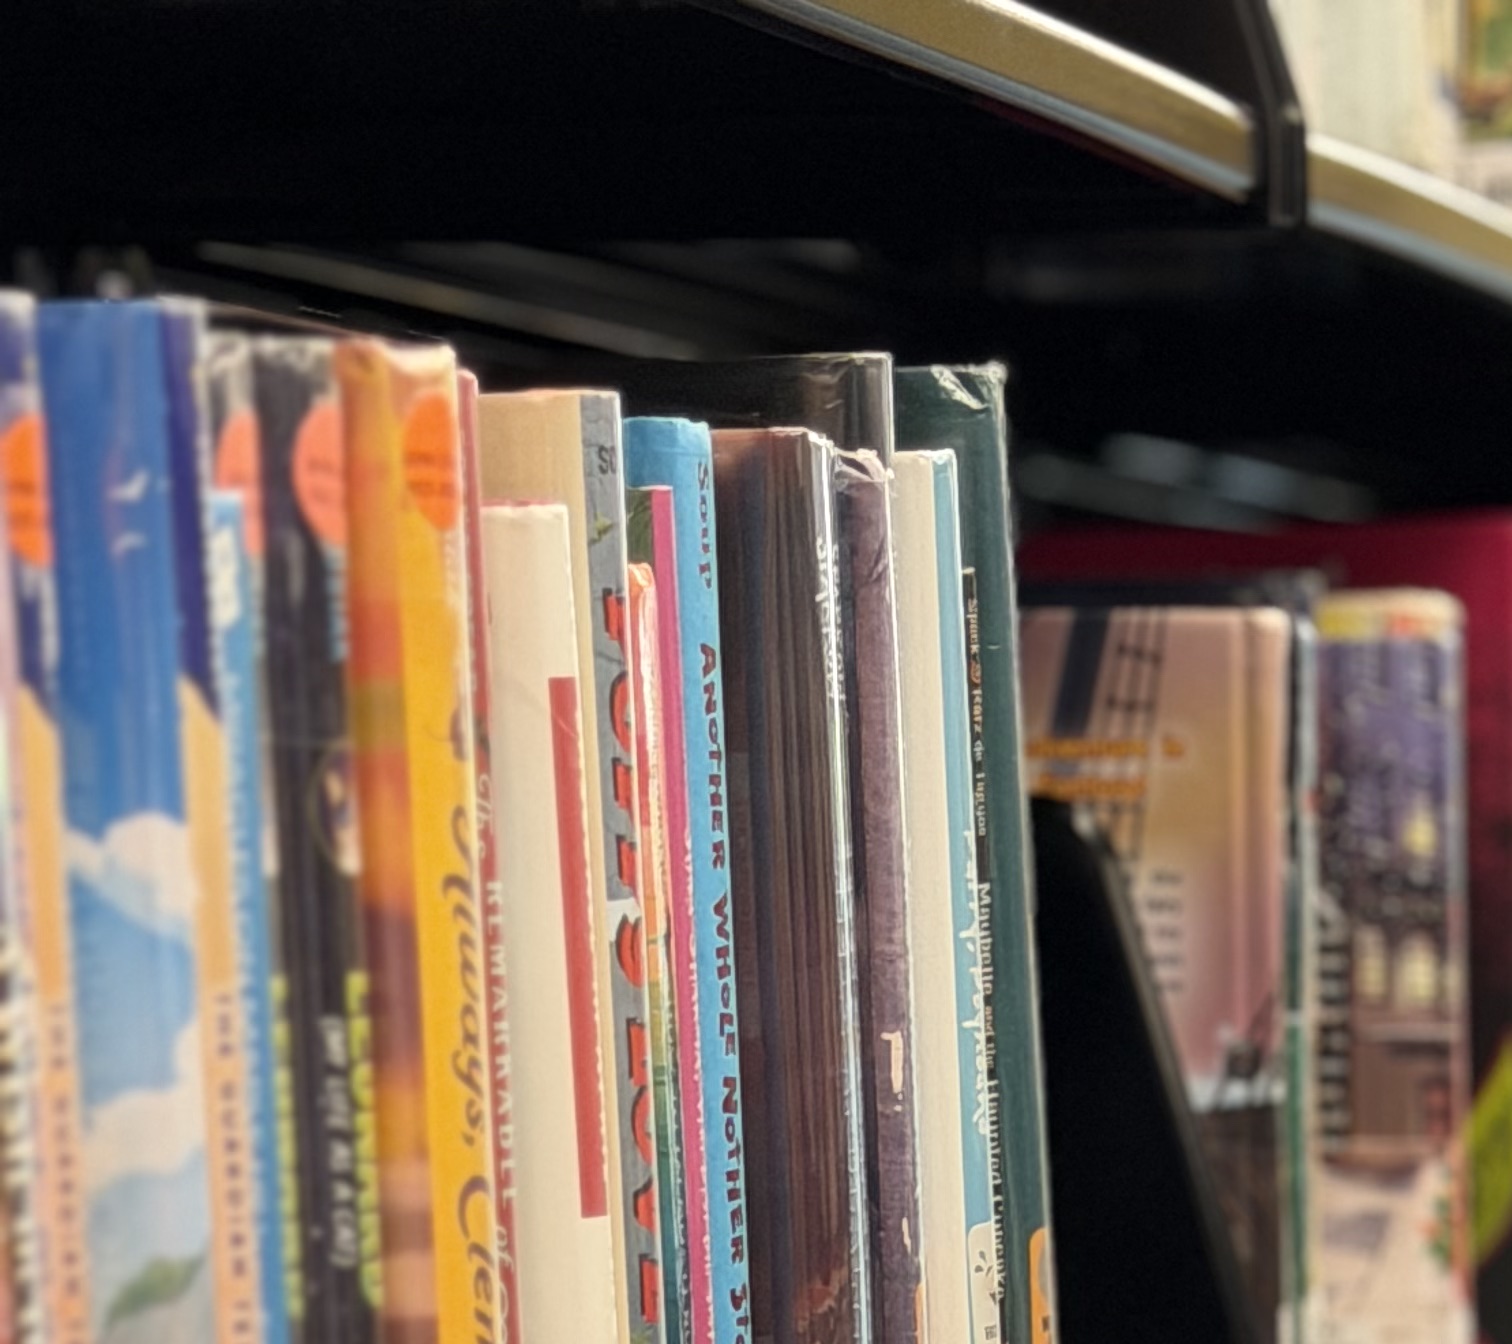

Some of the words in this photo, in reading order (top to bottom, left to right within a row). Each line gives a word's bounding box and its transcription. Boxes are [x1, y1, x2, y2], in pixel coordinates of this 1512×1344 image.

[699, 642, 727, 871] ANOTHER
[486, 880, 518, 1209] REMARKABLE
[710, 893, 736, 1058] WHOLE
[720, 1075, 746, 1265] NOTHER
